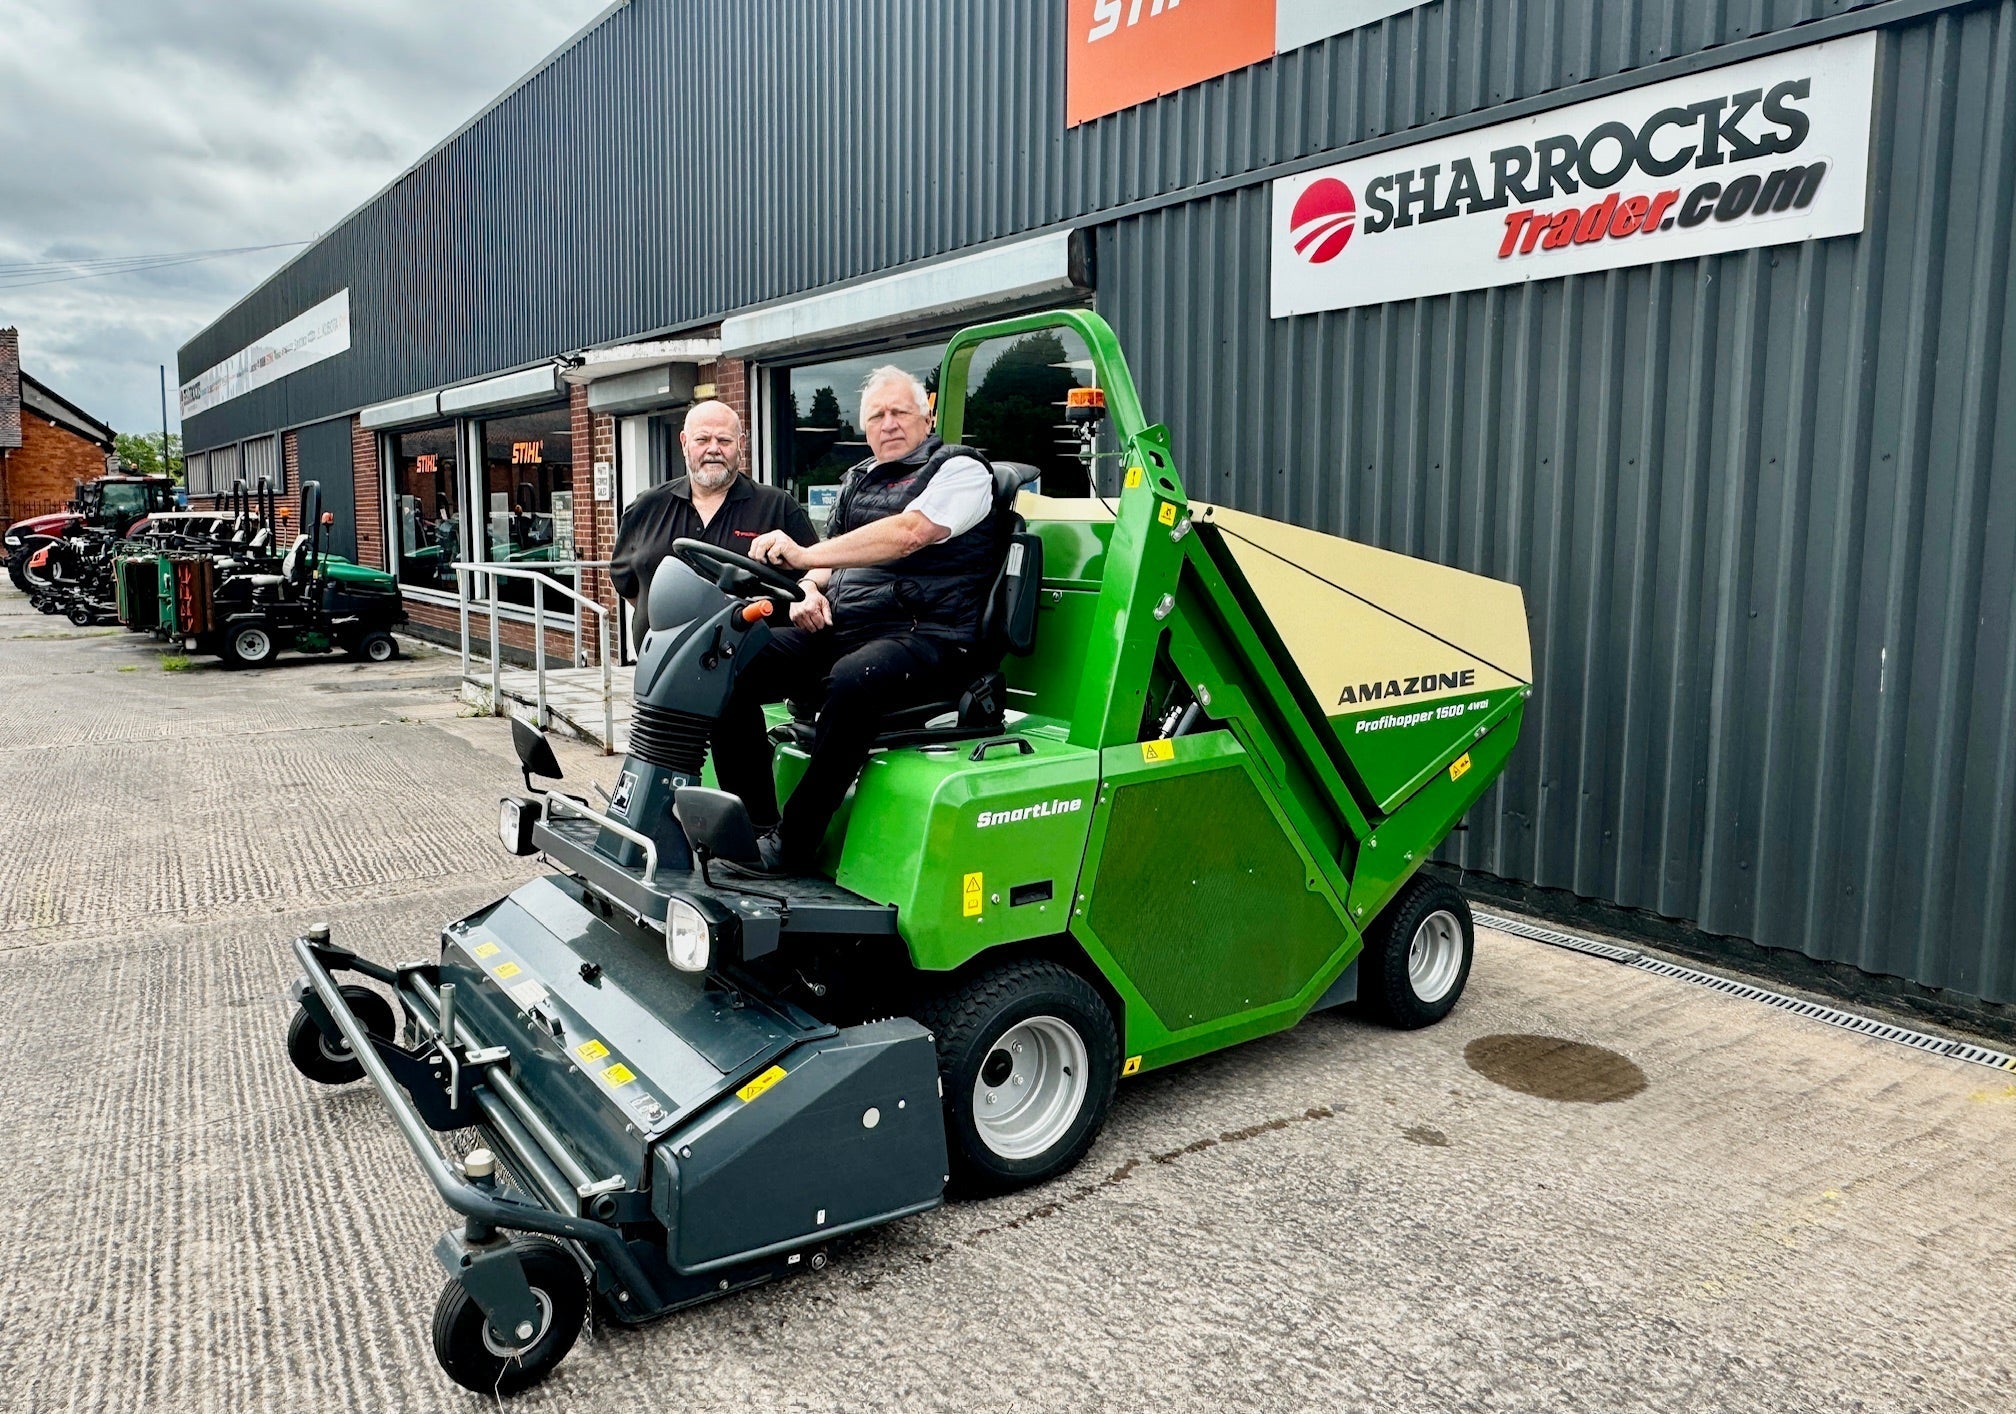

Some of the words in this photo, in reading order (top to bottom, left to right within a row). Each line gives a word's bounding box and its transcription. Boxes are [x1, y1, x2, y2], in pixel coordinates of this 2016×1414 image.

[1364, 78, 1810, 235] SHARROCKS
[1499, 159, 1827, 258] Trader.com
[417, 455, 438, 473] STIHL
[512, 441, 543, 464] STIHL
[1338, 669, 1475, 705] AMAZONE
[1355, 711, 1434, 734] Profihopper
[1436, 705, 1464, 719] 1500
[977, 798, 1082, 828] SmartLine
